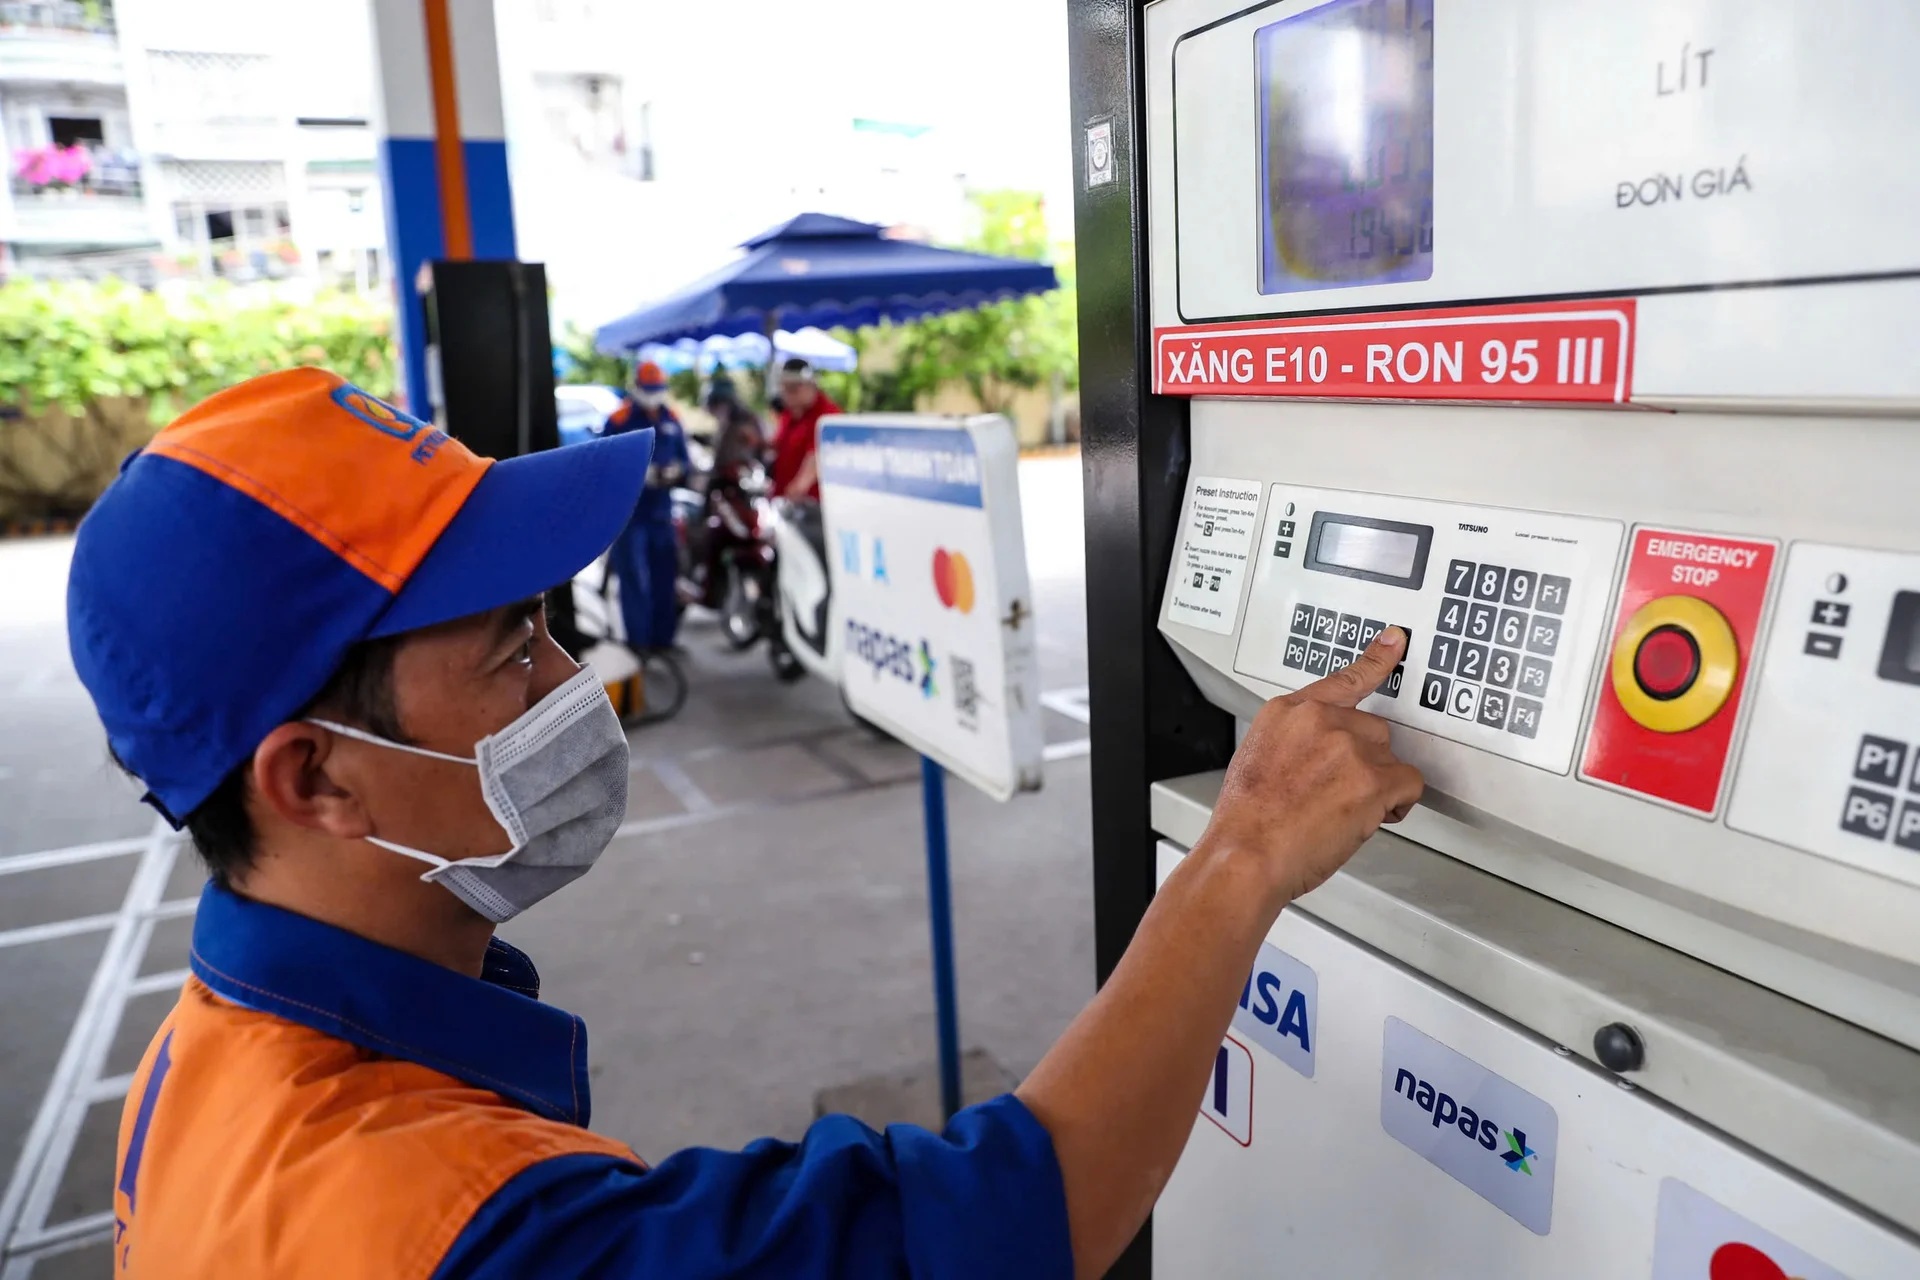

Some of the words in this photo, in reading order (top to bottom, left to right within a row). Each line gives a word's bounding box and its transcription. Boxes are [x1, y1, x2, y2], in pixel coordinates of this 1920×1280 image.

[1656, 42, 1715, 97] LÍT
[1616, 173, 1683, 208] ĐƠN
[1691, 154, 1752, 198] GIÁ
[1168, 342, 1254, 384] XĂNG
[1265, 346, 1328, 383] E10
[1366, 341, 1464, 383] RON
[1480, 338, 1539, 384] 95
[1556, 337, 1604, 385] III
[1196, 486, 1218, 498] Preset
[1219, 488, 1258, 501] Instruction
[1458, 523, 1488, 533] TATSUNO
[1646, 538, 1758, 569] EMERGENCY
[1453, 565, 1470, 590] 7
[1481, 570, 1498, 596] 8
[1511, 575, 1528, 602] 9
[1541, 584, 1562, 604] F1
[1671, 564, 1720, 588] STOP
[1293, 609, 1311, 629] P1
[1315, 615, 1334, 635] P2
[1338, 620, 1358, 641] P3
[1444, 604, 1459, 630] 4
[1472, 610, 1489, 636] 5
[1503, 616, 1520, 643] 6
[1532, 625, 1555, 646] F2
[846, 618, 914, 683] napas
[1286, 643, 1304, 663] P6
[1308, 649, 1327, 668] P7
[1387, 672, 1401, 691] 10
[1439, 642, 1449, 667] 1
[1463, 649, 1480, 676] 2
[1493, 656, 1511, 683] 3
[1523, 667, 1545, 687] F3
[1427, 680, 1442, 706] 0
[1454, 688, 1473, 714] C
[1514, 708, 1536, 728] F4
[1858, 743, 1900, 778] P1
[1846, 795, 1890, 832] P6
[1394, 1067, 1499, 1151] napas
